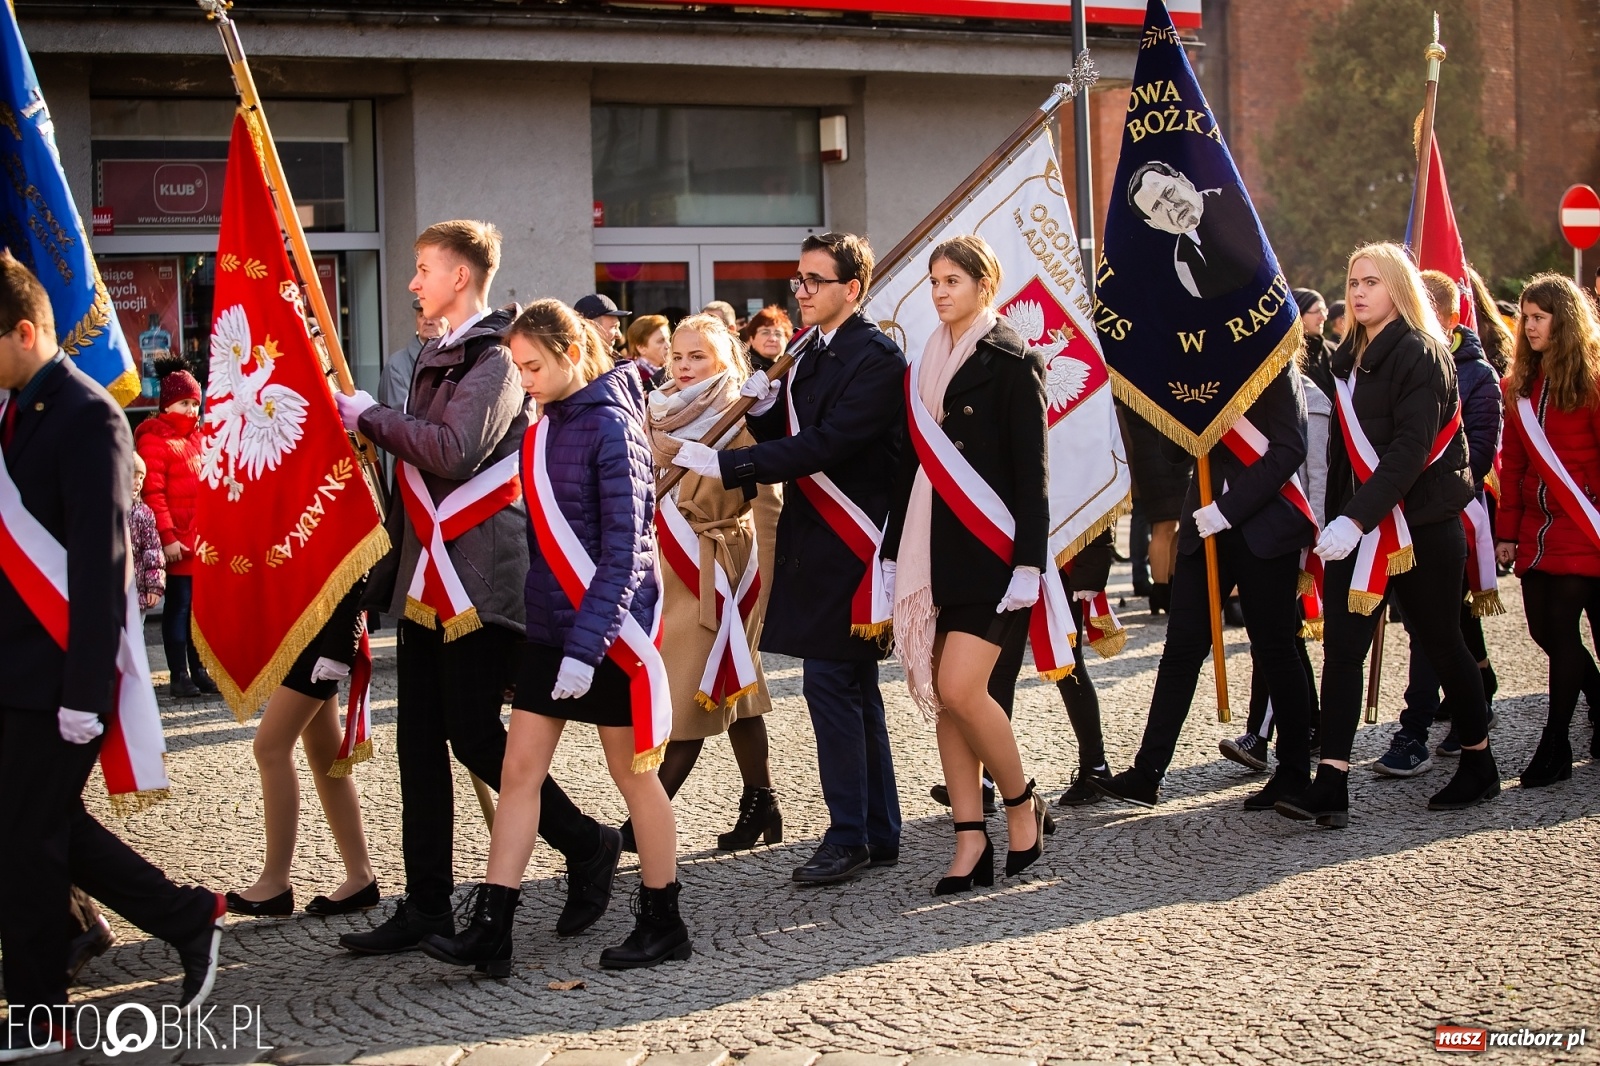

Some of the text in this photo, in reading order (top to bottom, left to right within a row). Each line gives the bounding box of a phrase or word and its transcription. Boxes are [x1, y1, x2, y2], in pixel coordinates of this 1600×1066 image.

[1126, 104, 1222, 144] BOŻKA
[159, 184, 196, 196] KLUB
[1022, 228, 1077, 296] ADAMA
[1176, 273, 1289, 353] W RACIB
[274, 474, 346, 559] NAUKA
